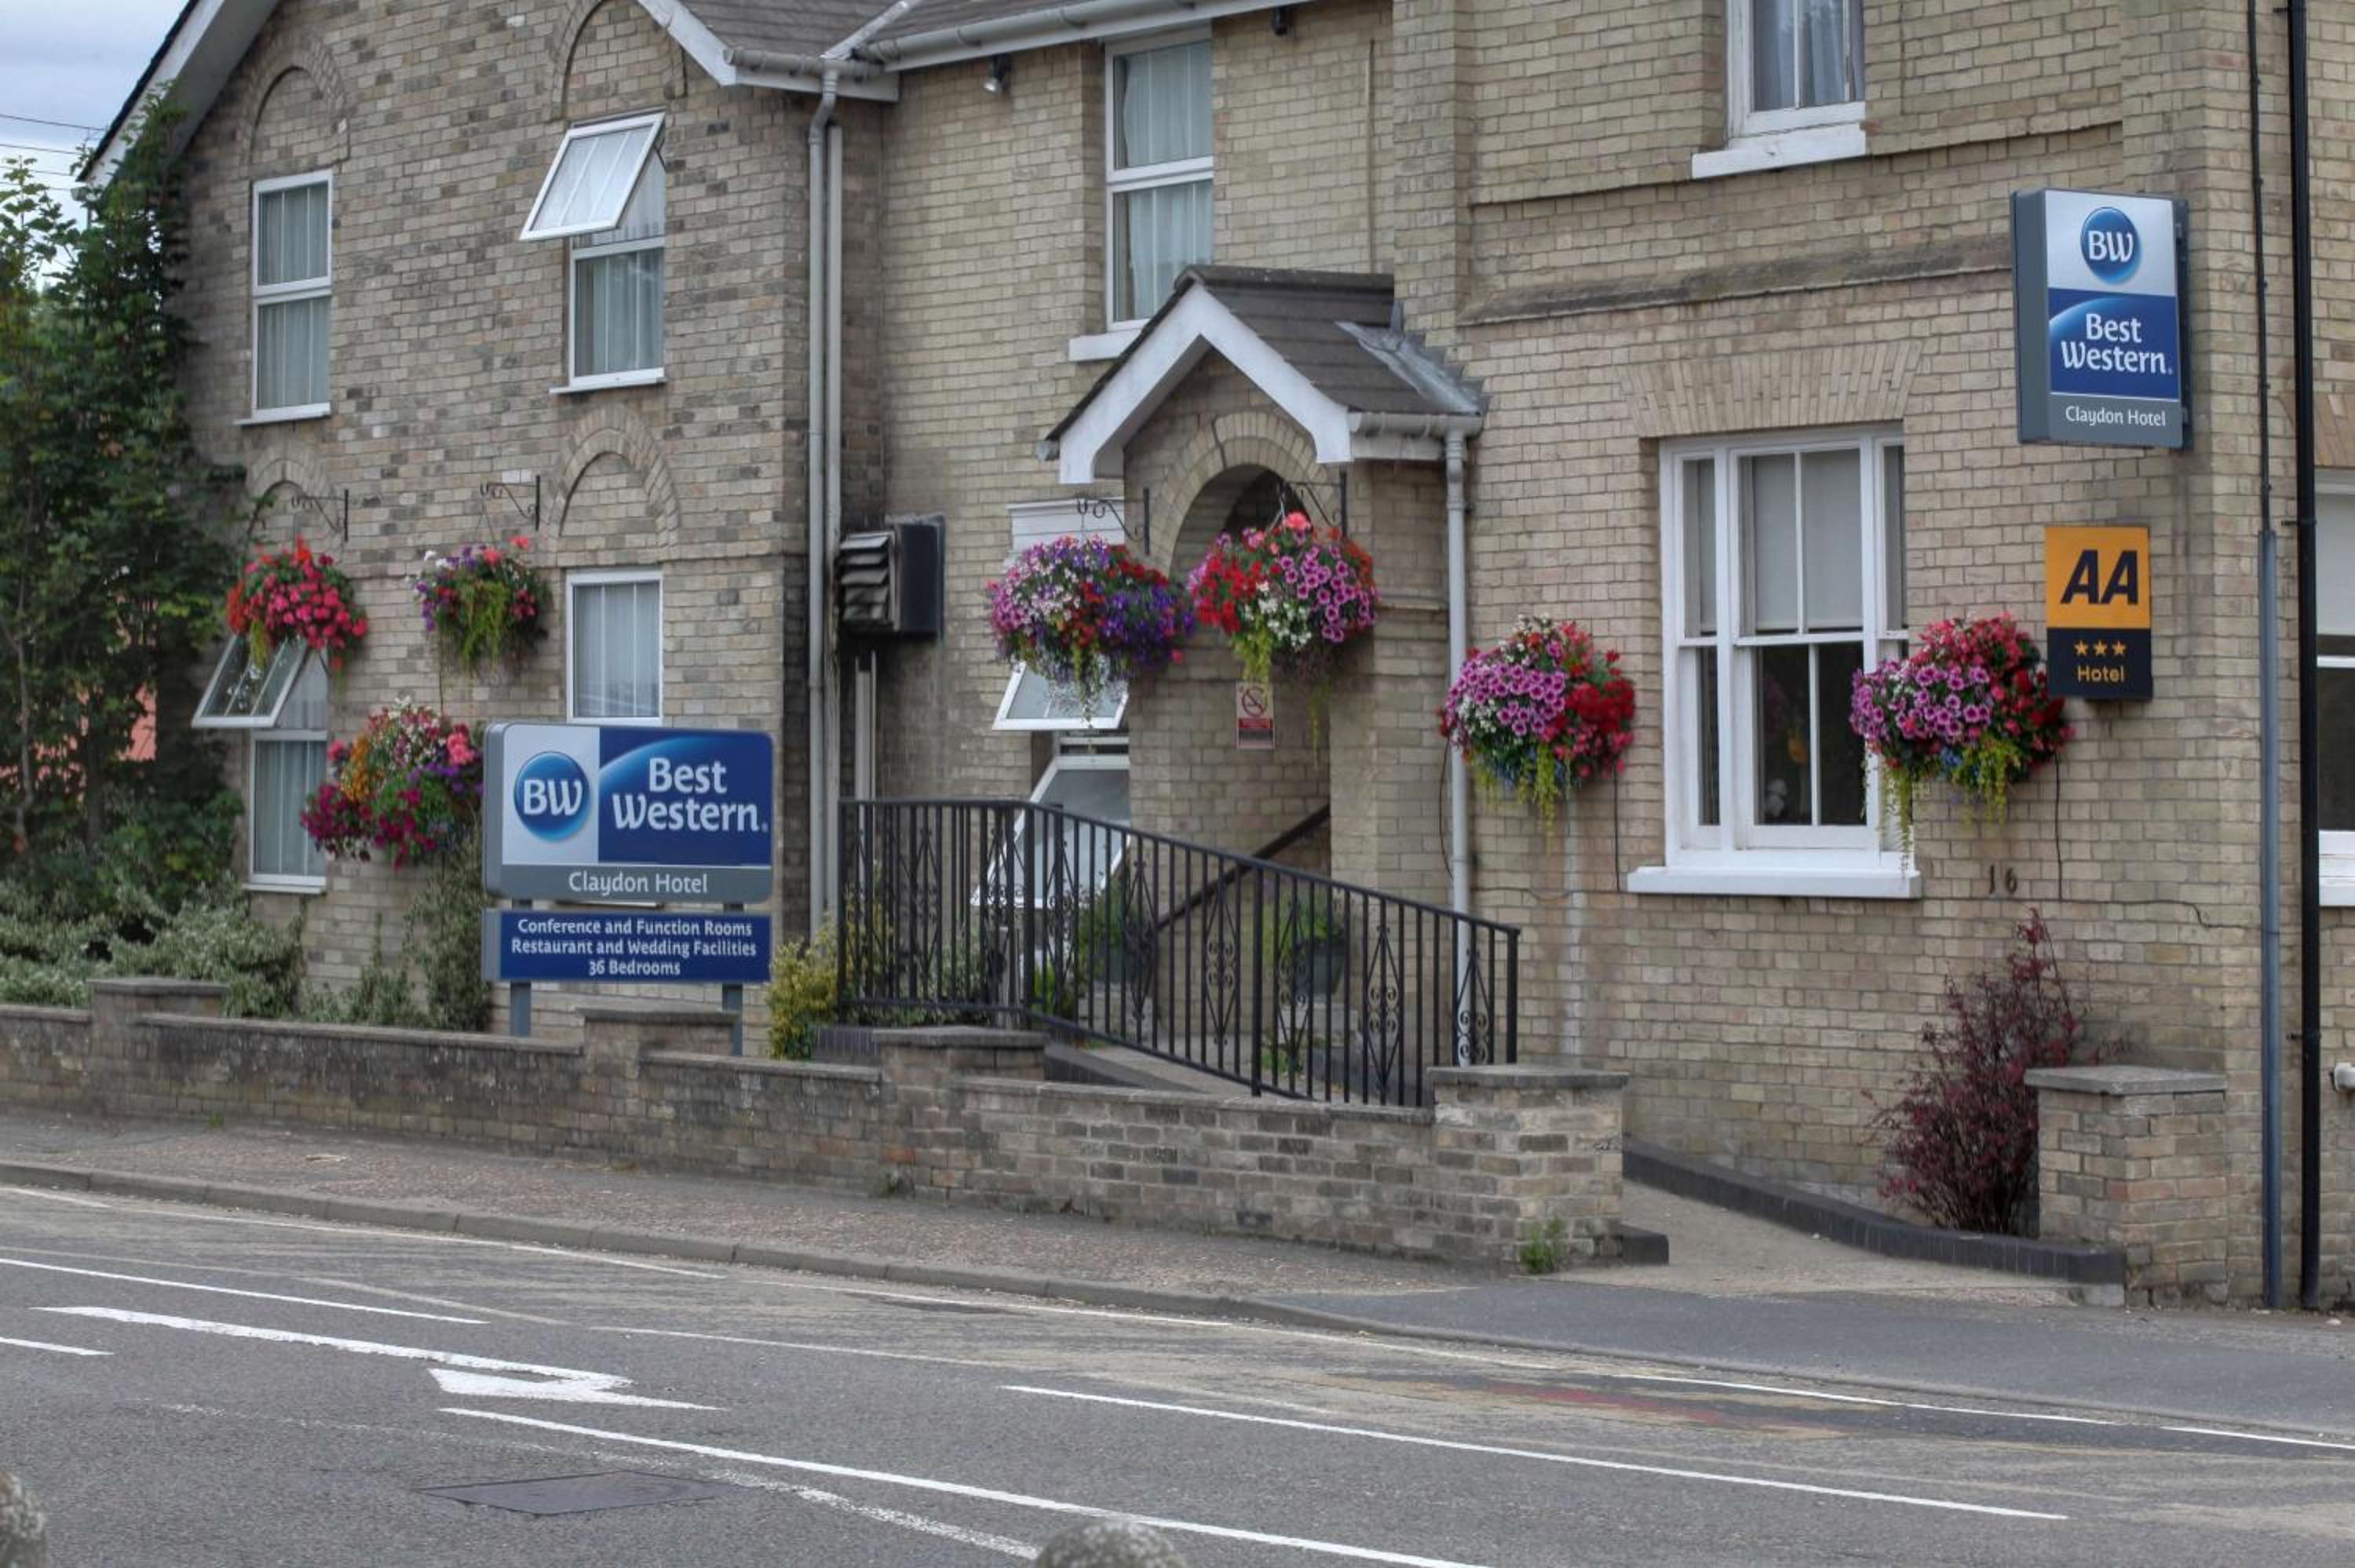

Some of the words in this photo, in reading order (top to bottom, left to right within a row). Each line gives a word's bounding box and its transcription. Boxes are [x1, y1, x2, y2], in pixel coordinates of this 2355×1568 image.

[2088, 230, 2134, 263] BW
[2086, 313, 2141, 343] Best
[2065, 406, 2123, 425] Claydon
[2128, 408, 2166, 426] Hotel
[2060, 549, 2139, 604] AA
[2077, 665, 2124, 682] Hotel
[649, 757, 727, 793] Best
[524, 779, 582, 815] BW
[568, 871, 648, 896] Claydon
[655, 873, 707, 893] Hotel
[1988, 864, 2017, 895] 16
[517, 919, 601, 933] Conference
[605, 920, 631, 934] and
[637, 920, 699, 935] Function
[705, 921, 752, 935] Rooms
[512, 939, 593, 954] Restaurant
[597, 940, 623, 954] and
[627, 940, 689, 958] Wedding
[694, 941, 756, 956] Facilities
[590, 960, 604, 975] 36
[609, 960, 680, 975] Bedrooms
